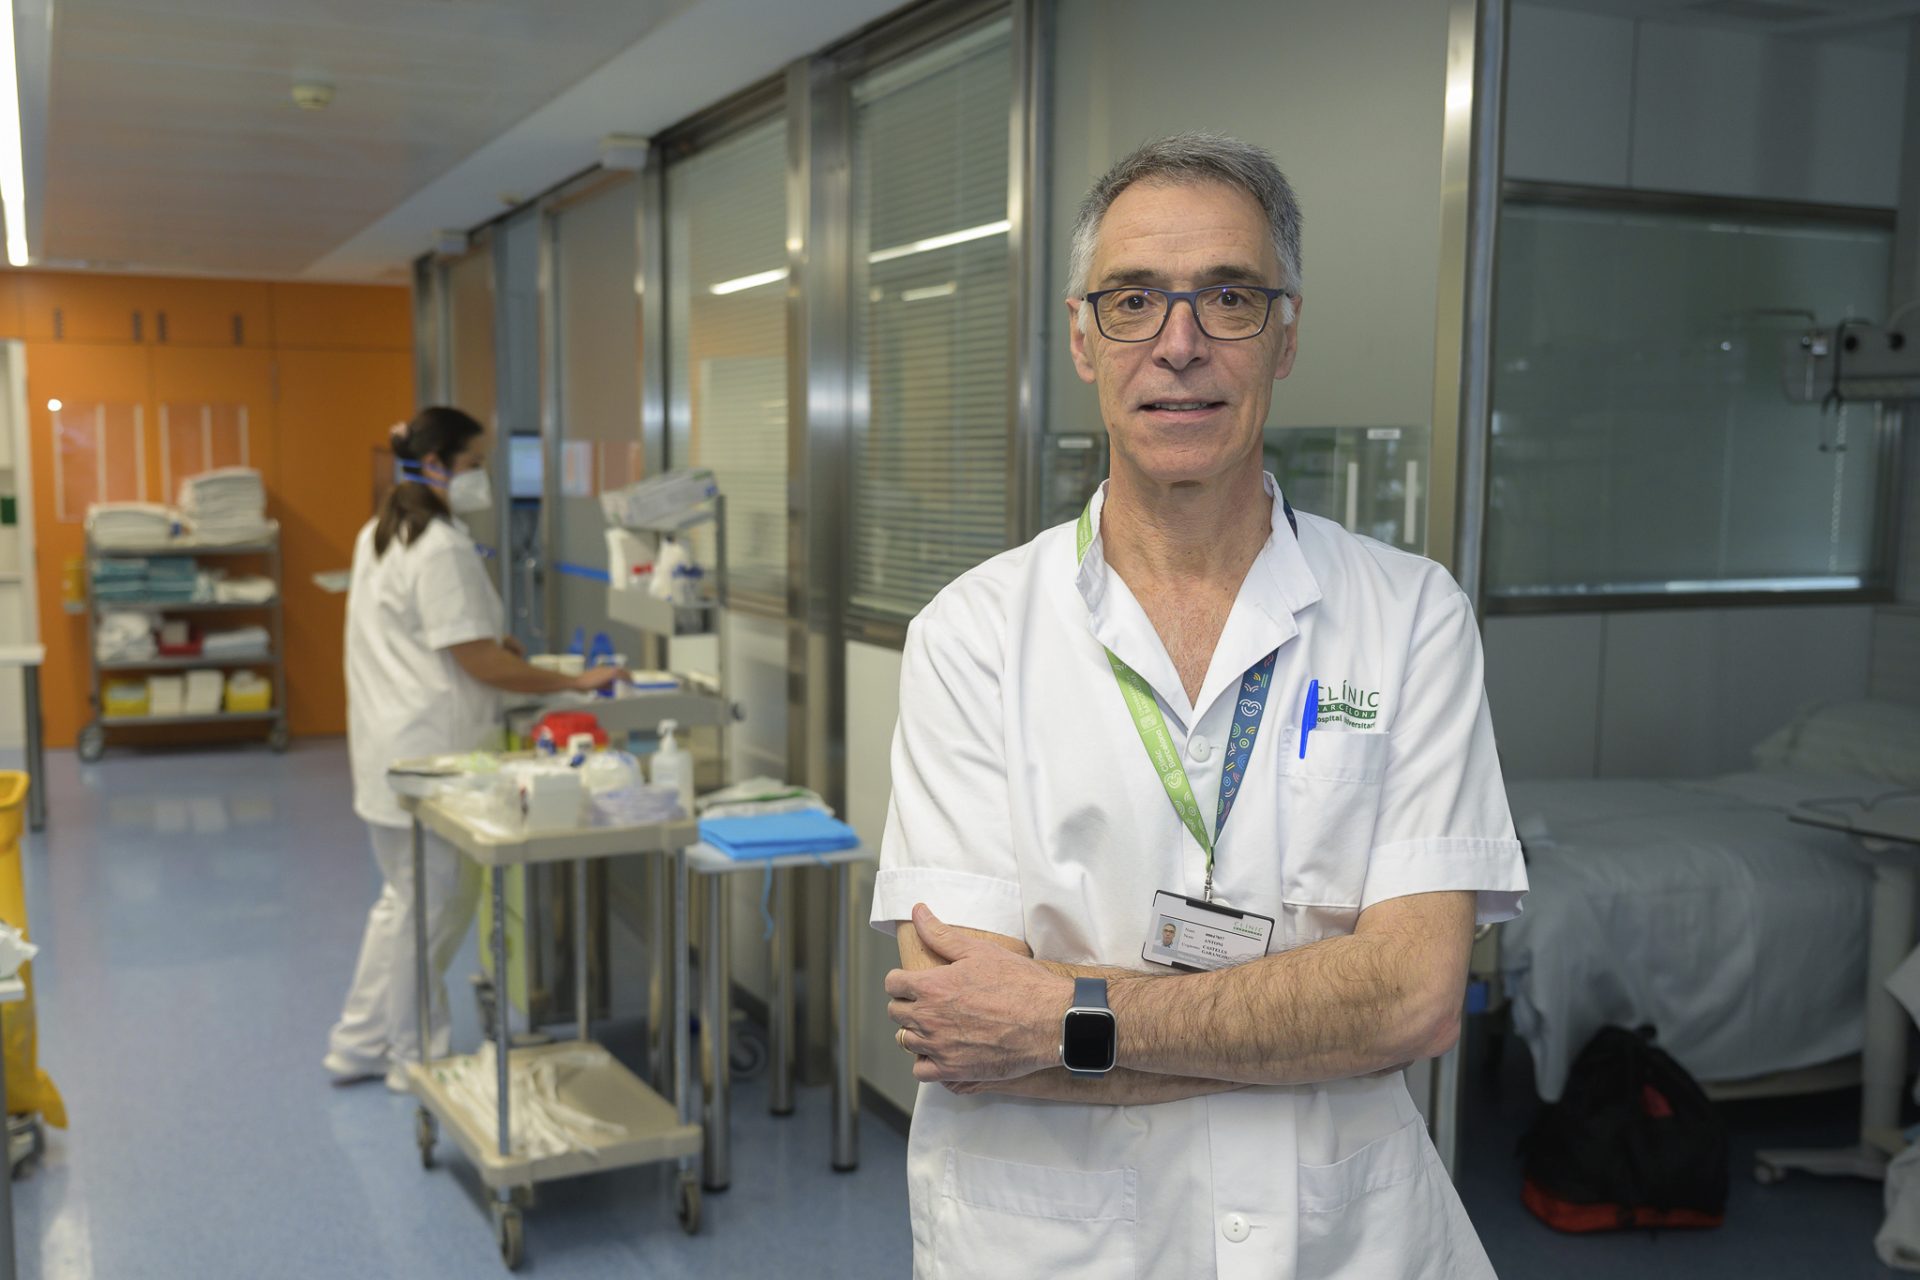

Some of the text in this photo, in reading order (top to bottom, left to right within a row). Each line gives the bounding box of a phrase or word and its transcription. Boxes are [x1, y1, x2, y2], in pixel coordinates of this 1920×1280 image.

[1318, 703, 1376, 718] ARCELONA
[1317, 715, 1343, 724] ospital
[1155, 729, 1176, 769] Barcelona
